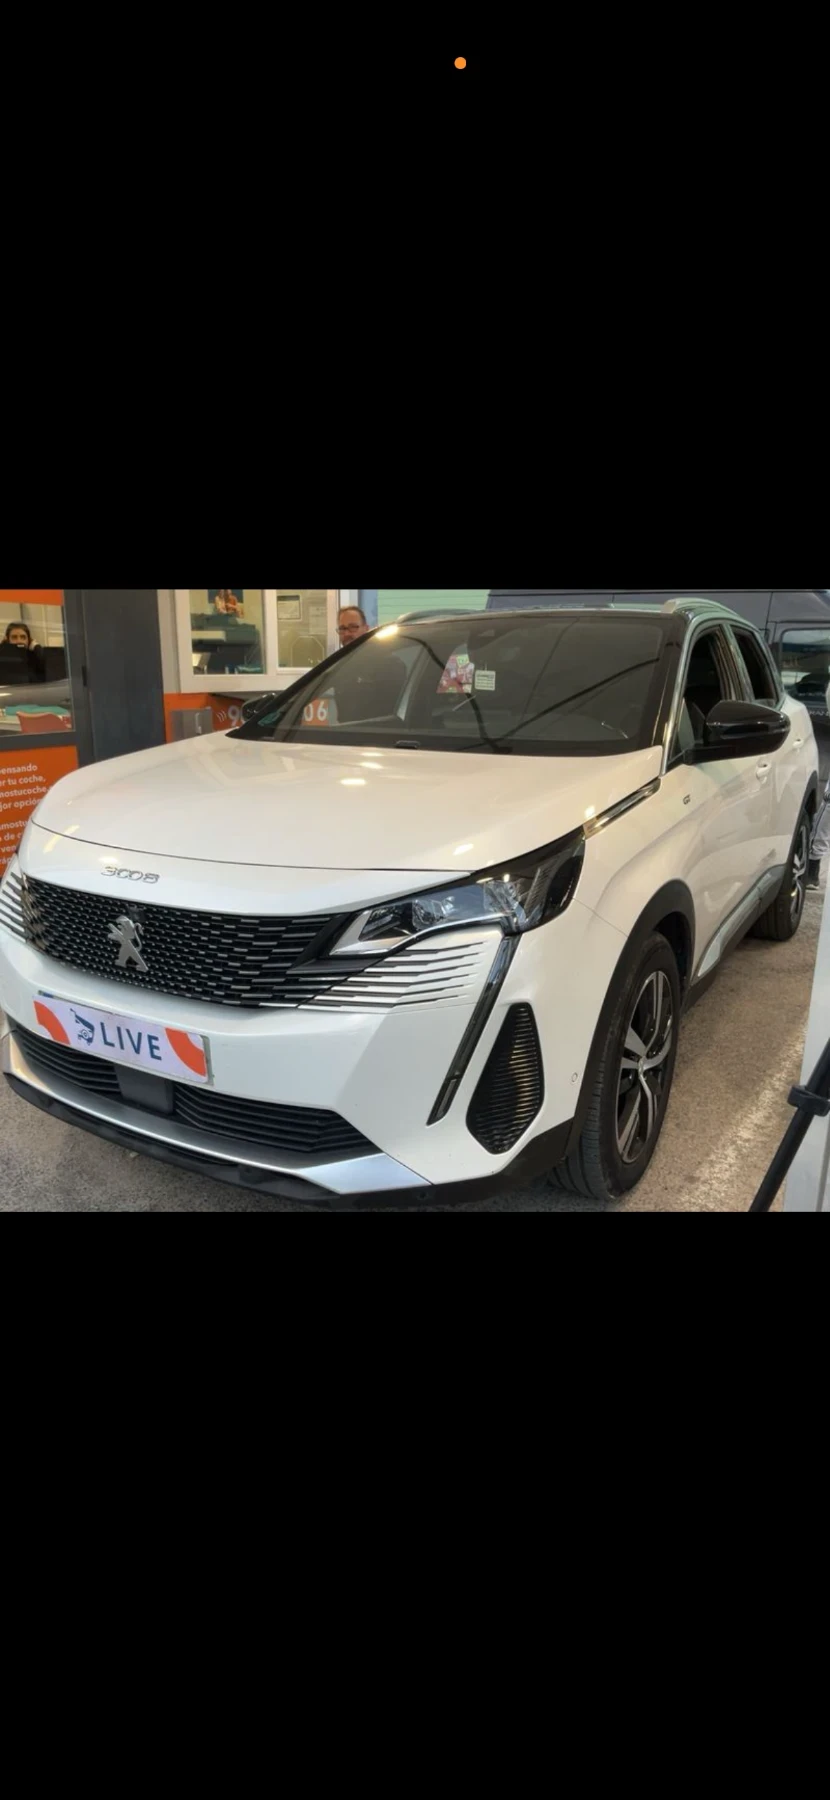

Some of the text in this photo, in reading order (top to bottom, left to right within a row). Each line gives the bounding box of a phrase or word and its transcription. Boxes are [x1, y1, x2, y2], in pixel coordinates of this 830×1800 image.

[0, 763, 38, 775] ensando
[7, 777, 17, 785] tu
[101, 866, 160, 884] 3008
[100, 1022, 162, 1061] LIVE
